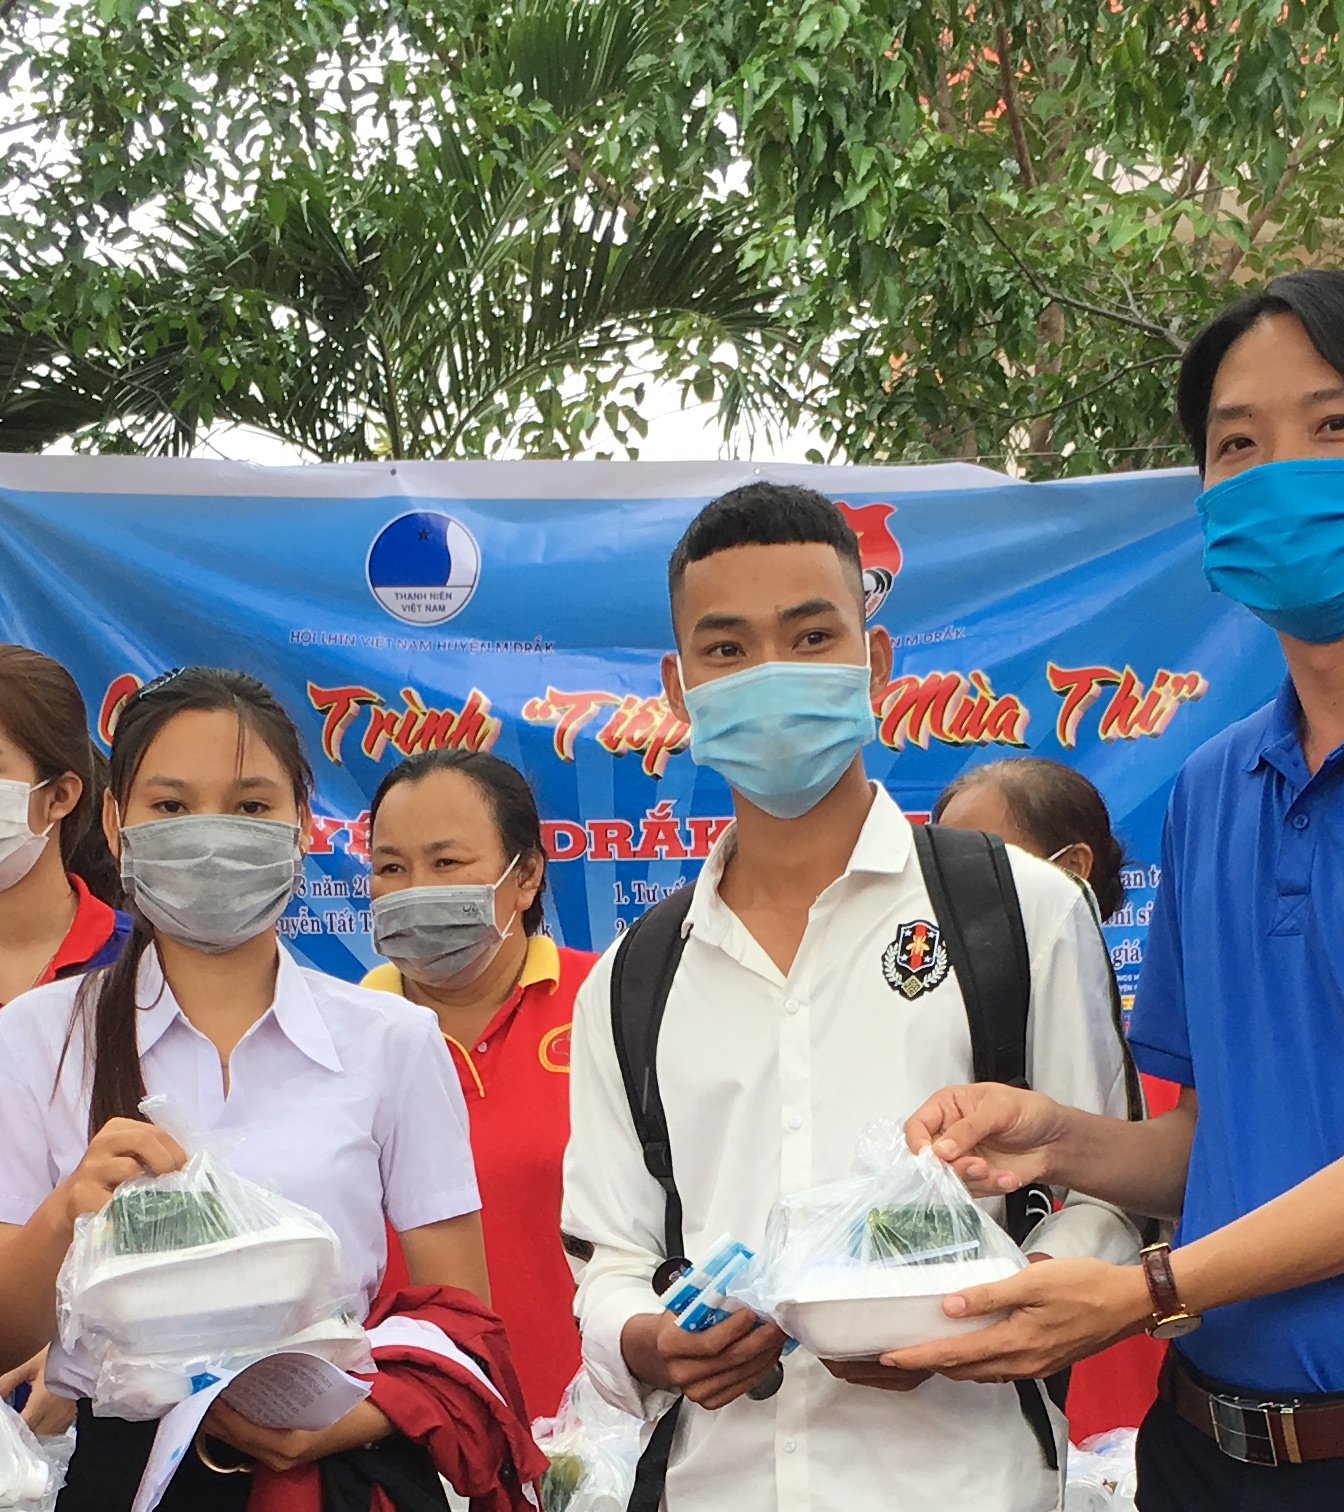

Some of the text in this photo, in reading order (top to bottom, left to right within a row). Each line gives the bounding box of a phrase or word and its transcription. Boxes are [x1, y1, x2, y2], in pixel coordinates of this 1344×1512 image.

[394, 592, 427, 601] THANH
[401, 602, 447, 614] VIỆT NAM
[289, 628, 317, 644] HỘI
[397, 638, 434, 652] NAM
[436, 640, 491, 655] HUYỆN
[307, 681, 502, 766] Trình
[870, 669, 1031, 751] Mùa
[312, 876, 349, 898] năm
[632, 881, 658, 905] Tư
[325, 907, 355, 934] Tất
